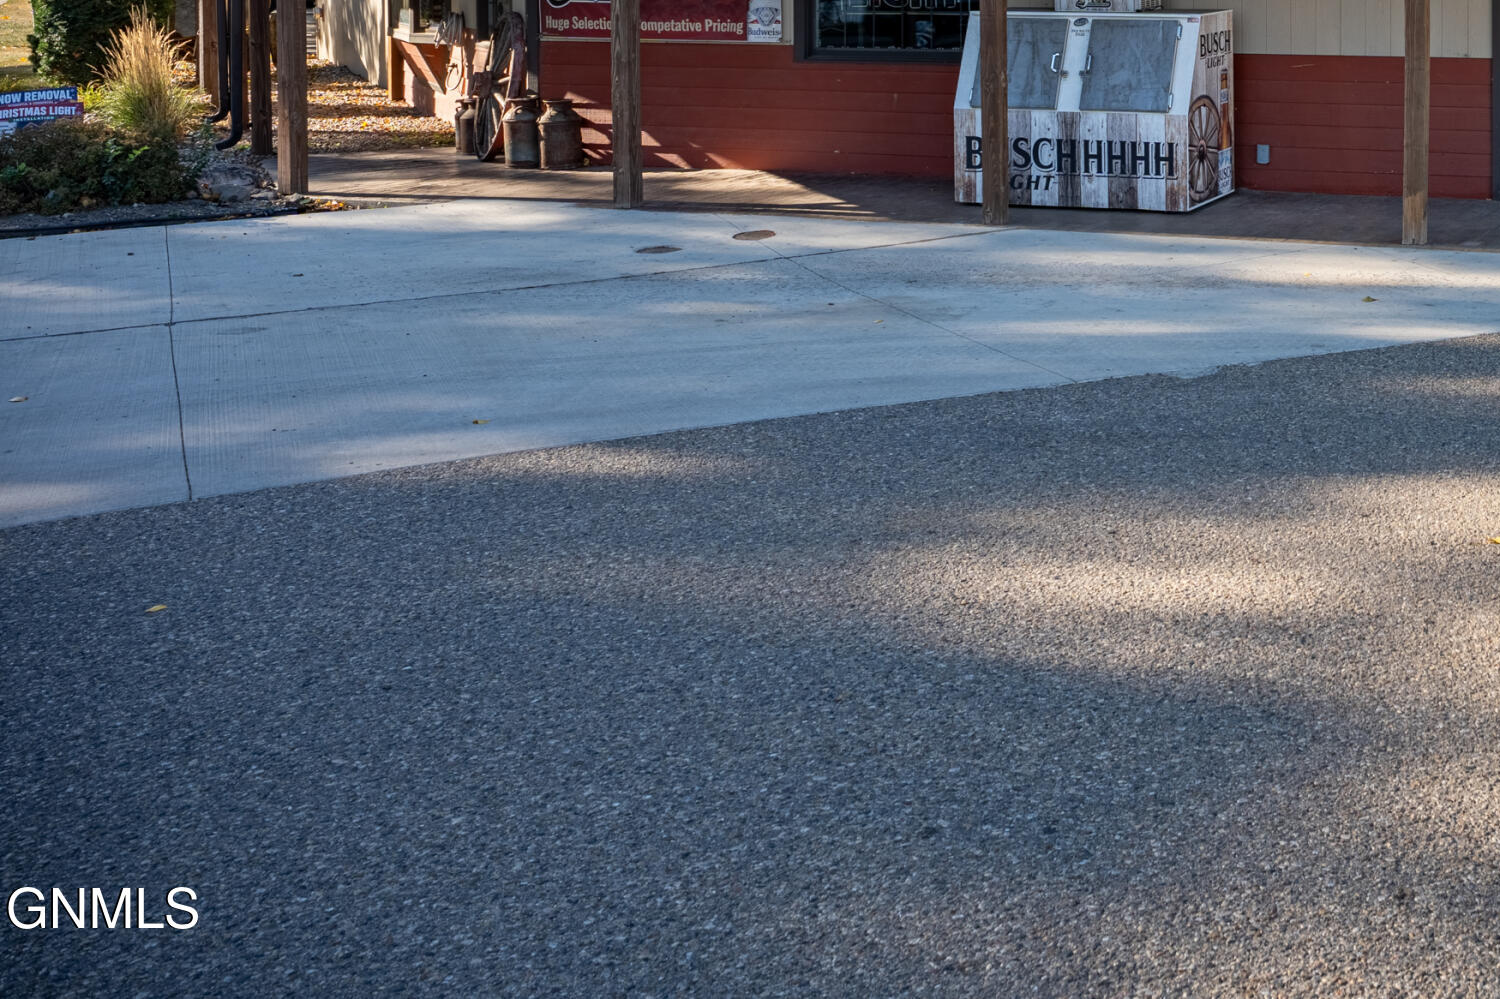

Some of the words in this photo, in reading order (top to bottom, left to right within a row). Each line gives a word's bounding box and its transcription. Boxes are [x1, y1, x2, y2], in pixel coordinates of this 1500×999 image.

[545, 15, 570, 31] Huge
[571, 16, 612, 31] Selectio
[640, 19, 702, 34] ompetative
[704, 16, 744, 35] Pricing
[747, 26, 781, 36] Budweis
[1200, 30, 1231, 60] BUSCH
[1207, 55, 1225, 69] LIGHT
[0, 93, 21, 104] NOW
[24, 89, 72, 101] REMOVAL
[0, 107, 47, 119] RISTMAS
[49, 106, 77, 115] LIGHT
[964, 135, 1178, 180] BSCHHHHH
[1009, 173, 1055, 192] GHT
